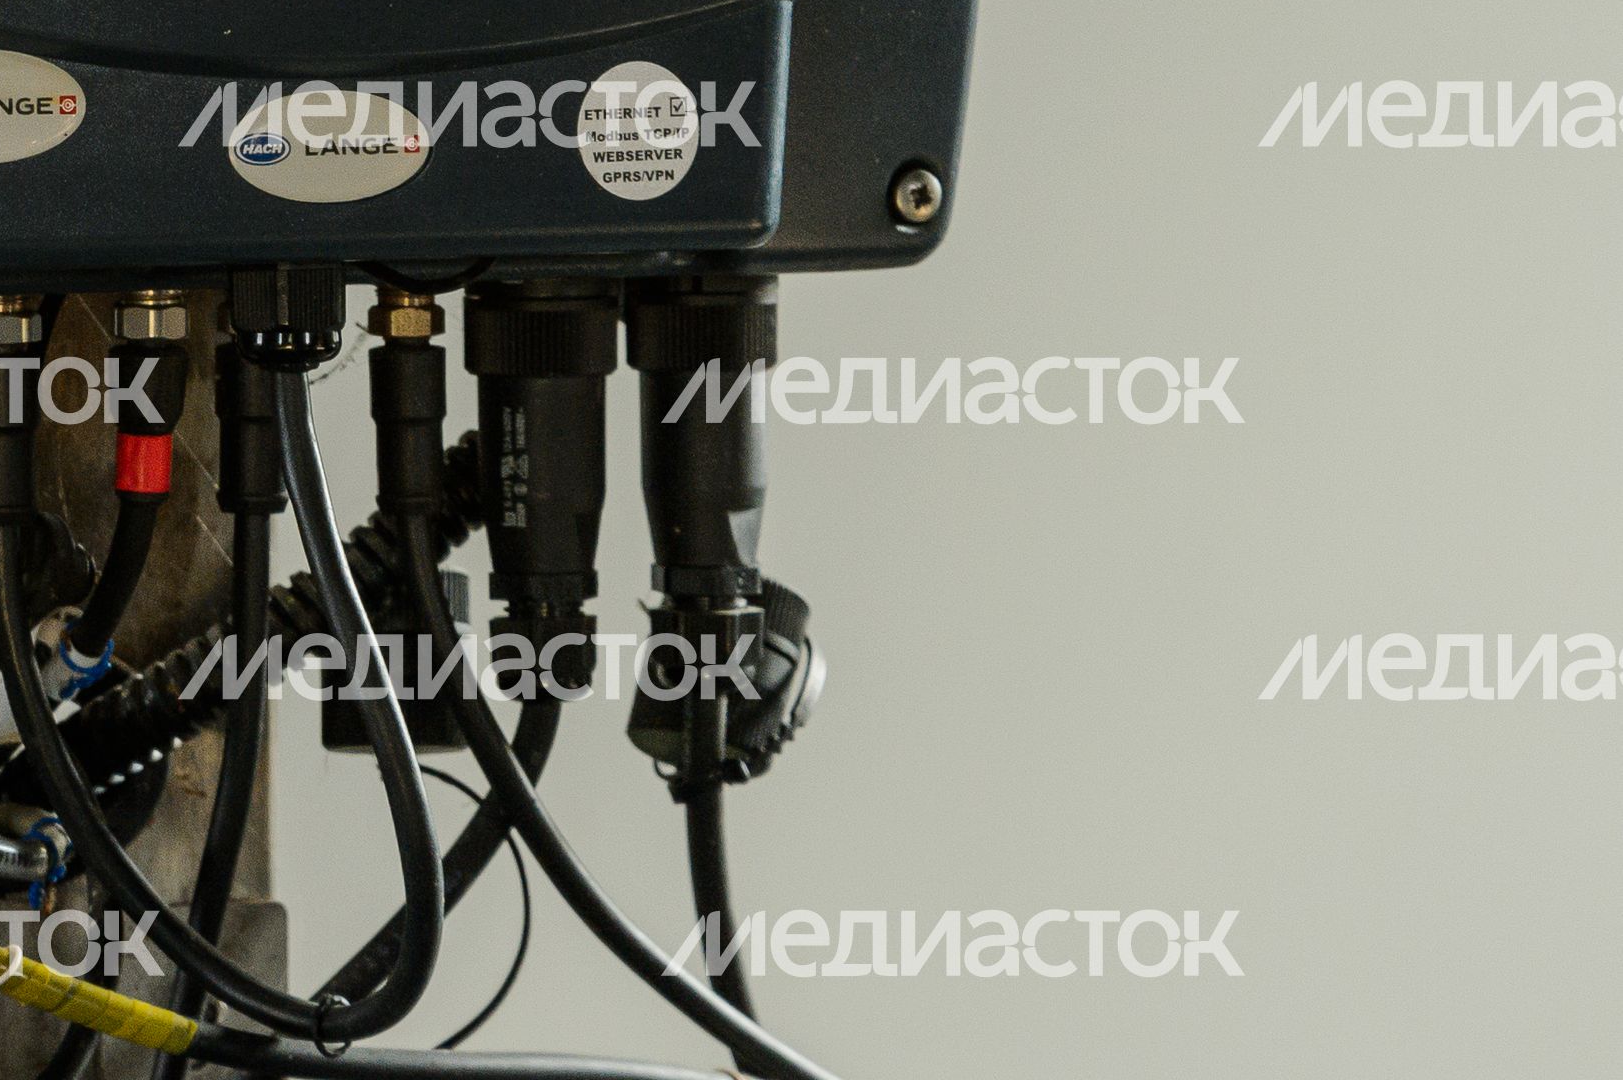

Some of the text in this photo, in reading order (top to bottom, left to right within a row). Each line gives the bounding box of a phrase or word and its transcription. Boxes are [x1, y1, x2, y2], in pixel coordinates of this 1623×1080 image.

[584, 107, 662, 121] ETHERNET
[585, 130, 639, 143] Modbus
[243, 137, 398, 156] HACH LANGE
[593, 148, 683, 163] WEBSERVER
[603, 169, 675, 184] GPRS/VPN
